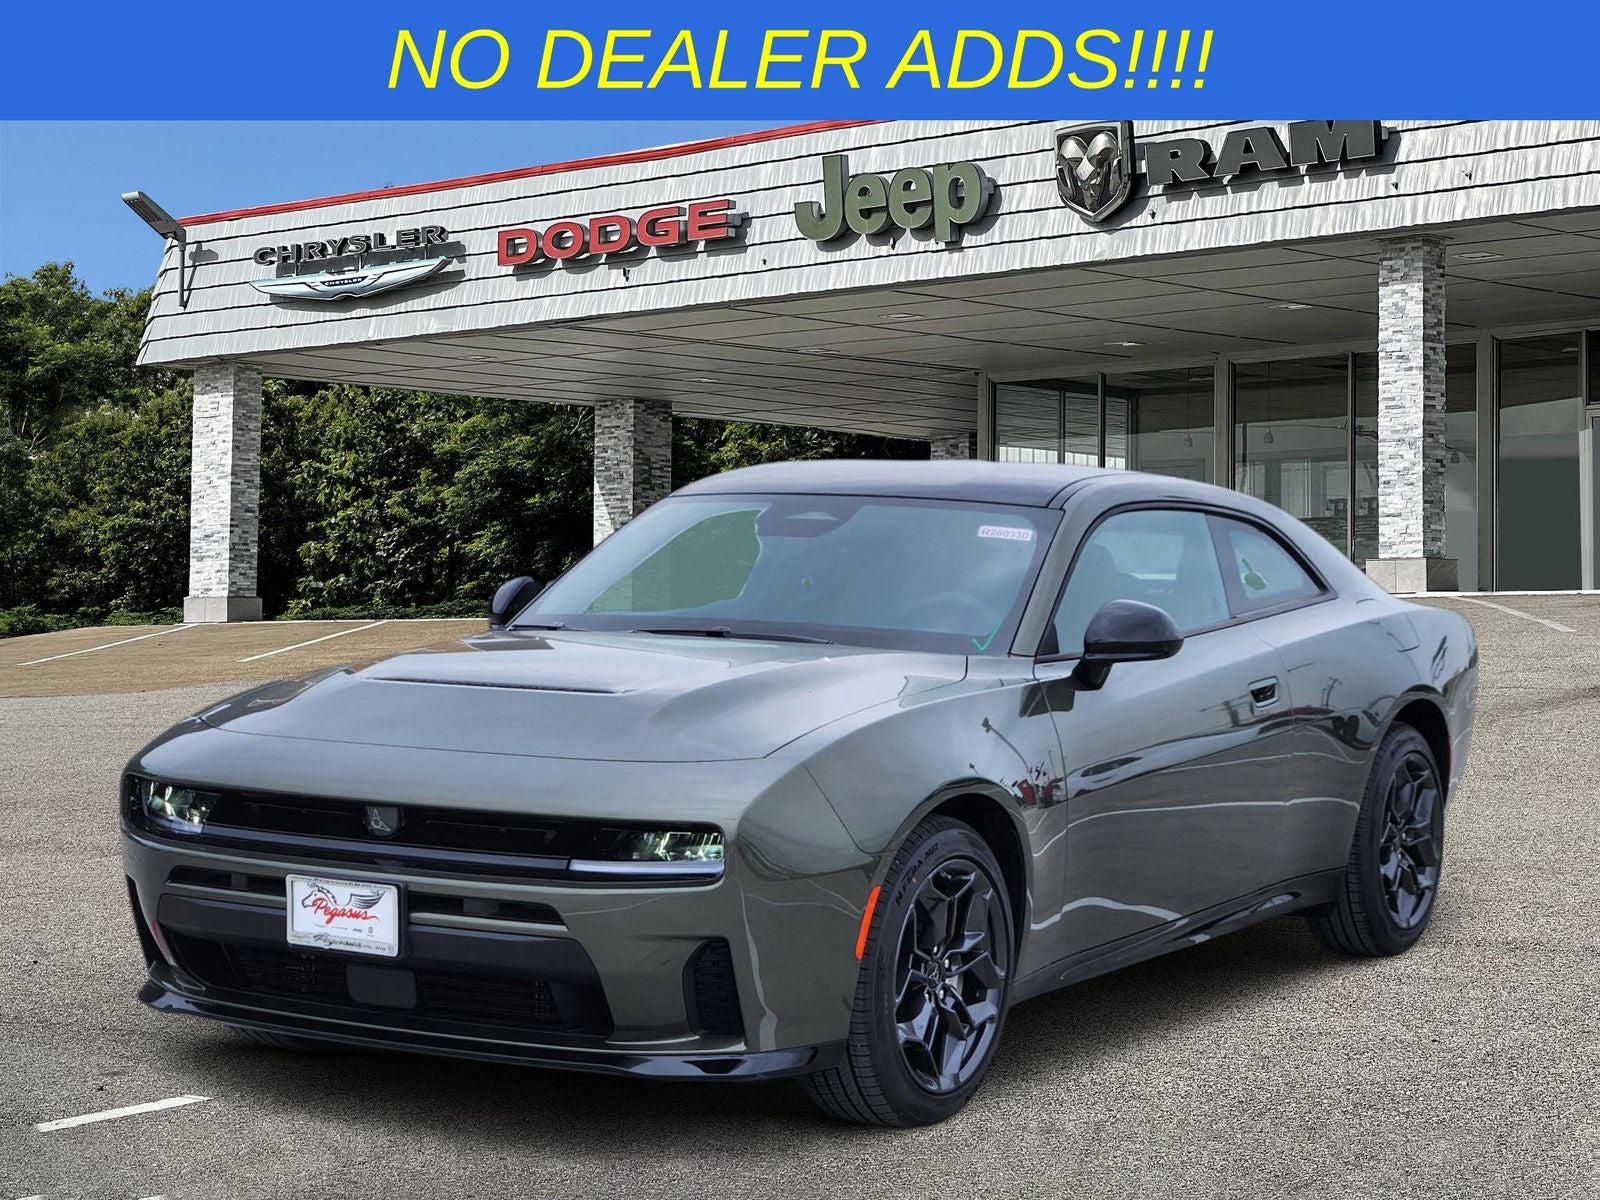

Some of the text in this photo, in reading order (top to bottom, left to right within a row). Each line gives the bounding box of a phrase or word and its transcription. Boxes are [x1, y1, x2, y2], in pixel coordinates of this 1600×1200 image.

[1143, 120, 1379, 186] RAM
[795, 154, 988, 243] Jeep
[253, 225, 448, 267] CHRYSLER
[498, 199, 735, 267] DODGE
[323, 277, 363, 287] CHRYSLER
[311, 897, 380, 925] Pegasus
